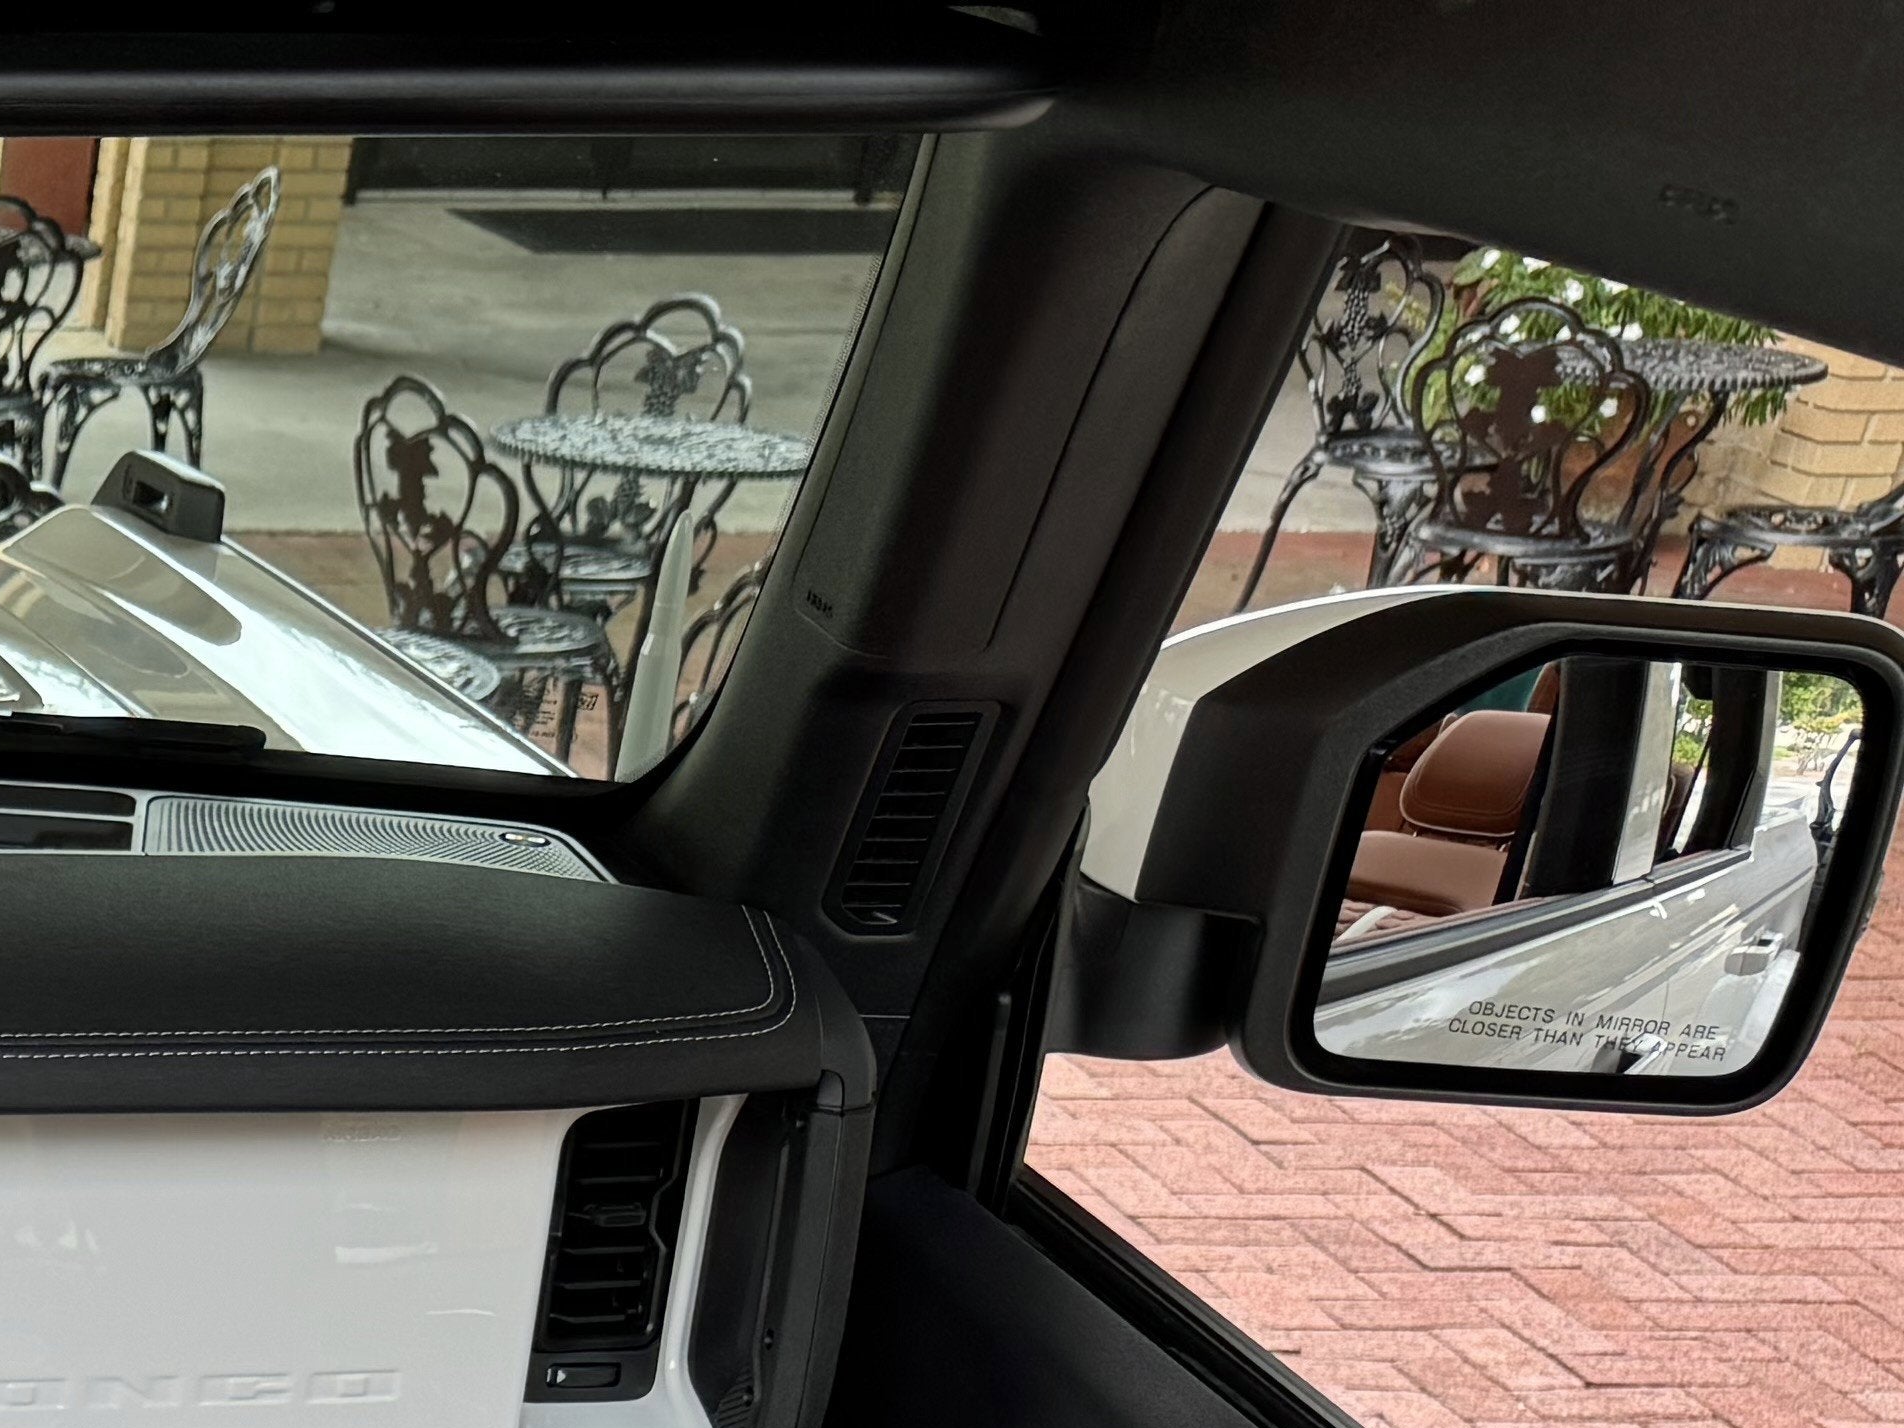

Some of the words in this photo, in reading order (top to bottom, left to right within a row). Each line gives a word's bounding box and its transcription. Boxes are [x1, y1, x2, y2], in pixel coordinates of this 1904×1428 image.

[1448, 1018, 1522, 1041] CLOSER
[1534, 1029, 1583, 1046] THAN
[1595, 1035, 1643, 1053] THEY
[1651, 1040, 1726, 1062] APPEAR
[1469, 1001, 1555, 1024] OBJECTS
[1566, 1011, 1585, 1026] IN
[1596, 1015, 1670, 1036] MIRROR
[1680, 1024, 1719, 1040] ARE
